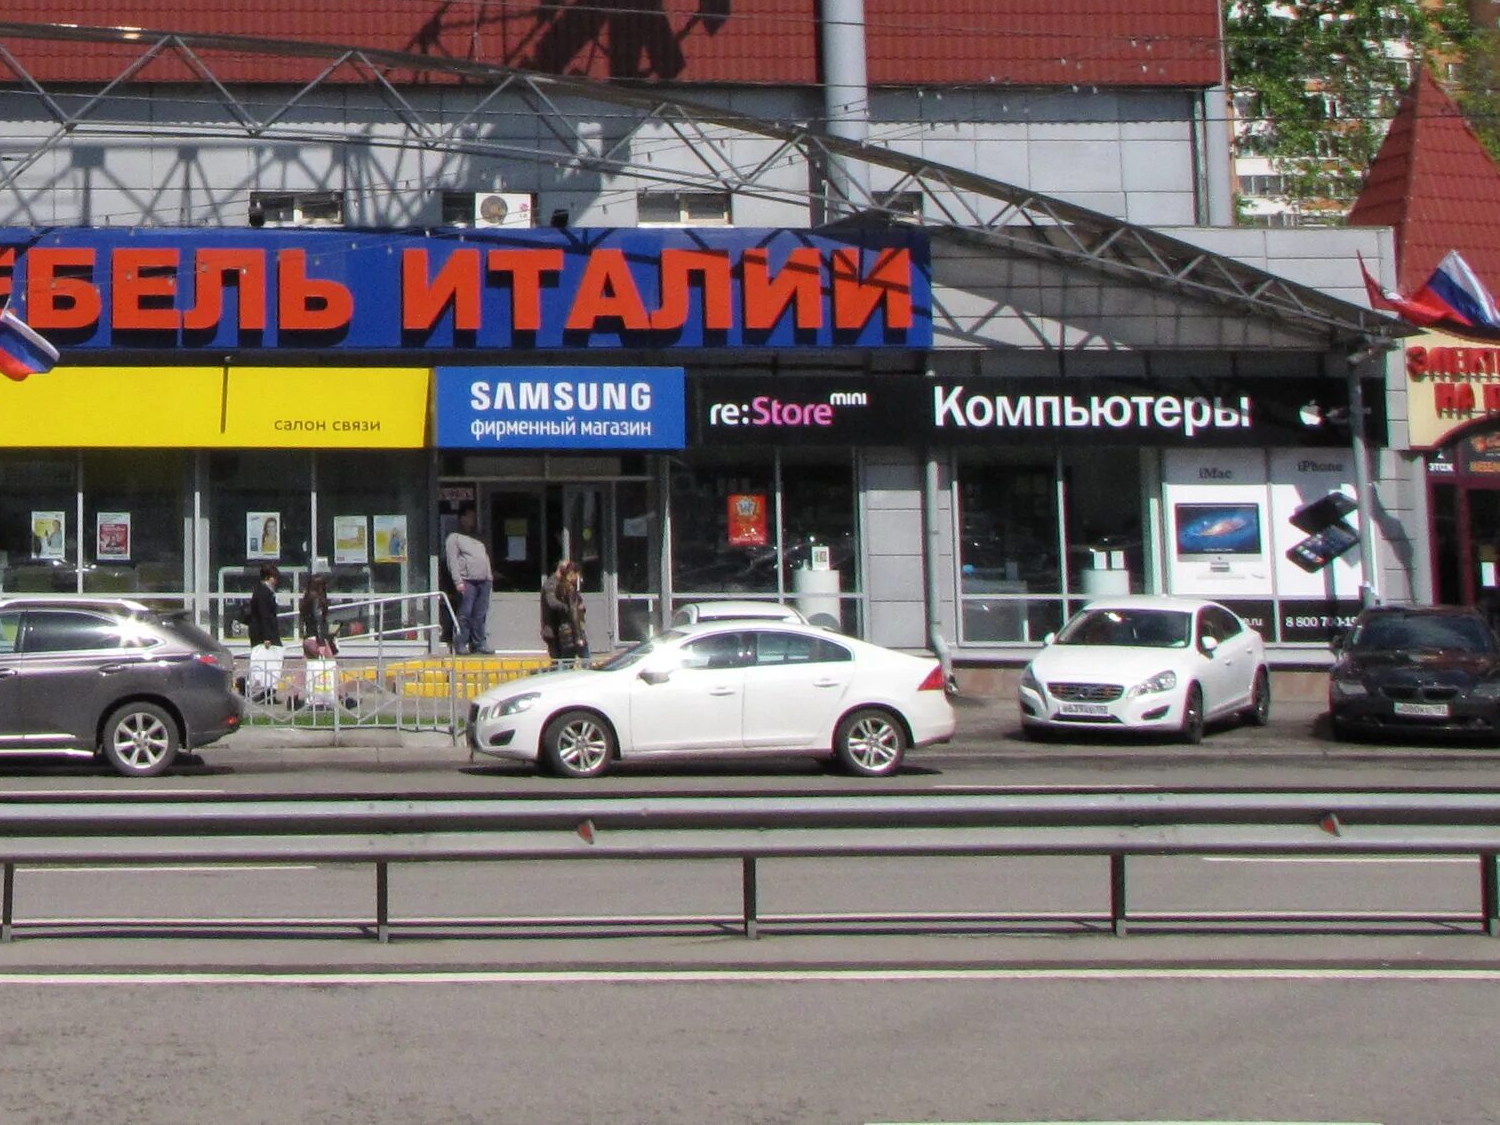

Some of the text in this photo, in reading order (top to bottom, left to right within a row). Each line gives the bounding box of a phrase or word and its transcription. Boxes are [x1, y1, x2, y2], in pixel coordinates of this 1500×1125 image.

[402, 248, 914, 331] ИТАЛИИ
[1406, 346, 1500, 382] ЭЛЕКТ
[470, 381, 652, 411] SAMSUNG
[710, 392, 868, 425] re:Store mini
[933, 385, 1250, 436] Компьютеры
[274, 420, 382, 431] салон связи
[470, 416, 652, 441] фирменный магазин
[1198, 467, 1232, 479] iMac
[1297, 460, 1344, 472] iPhone
[1285, 617, 1293, 627] 8
[1296, 617, 1318, 627] 800
